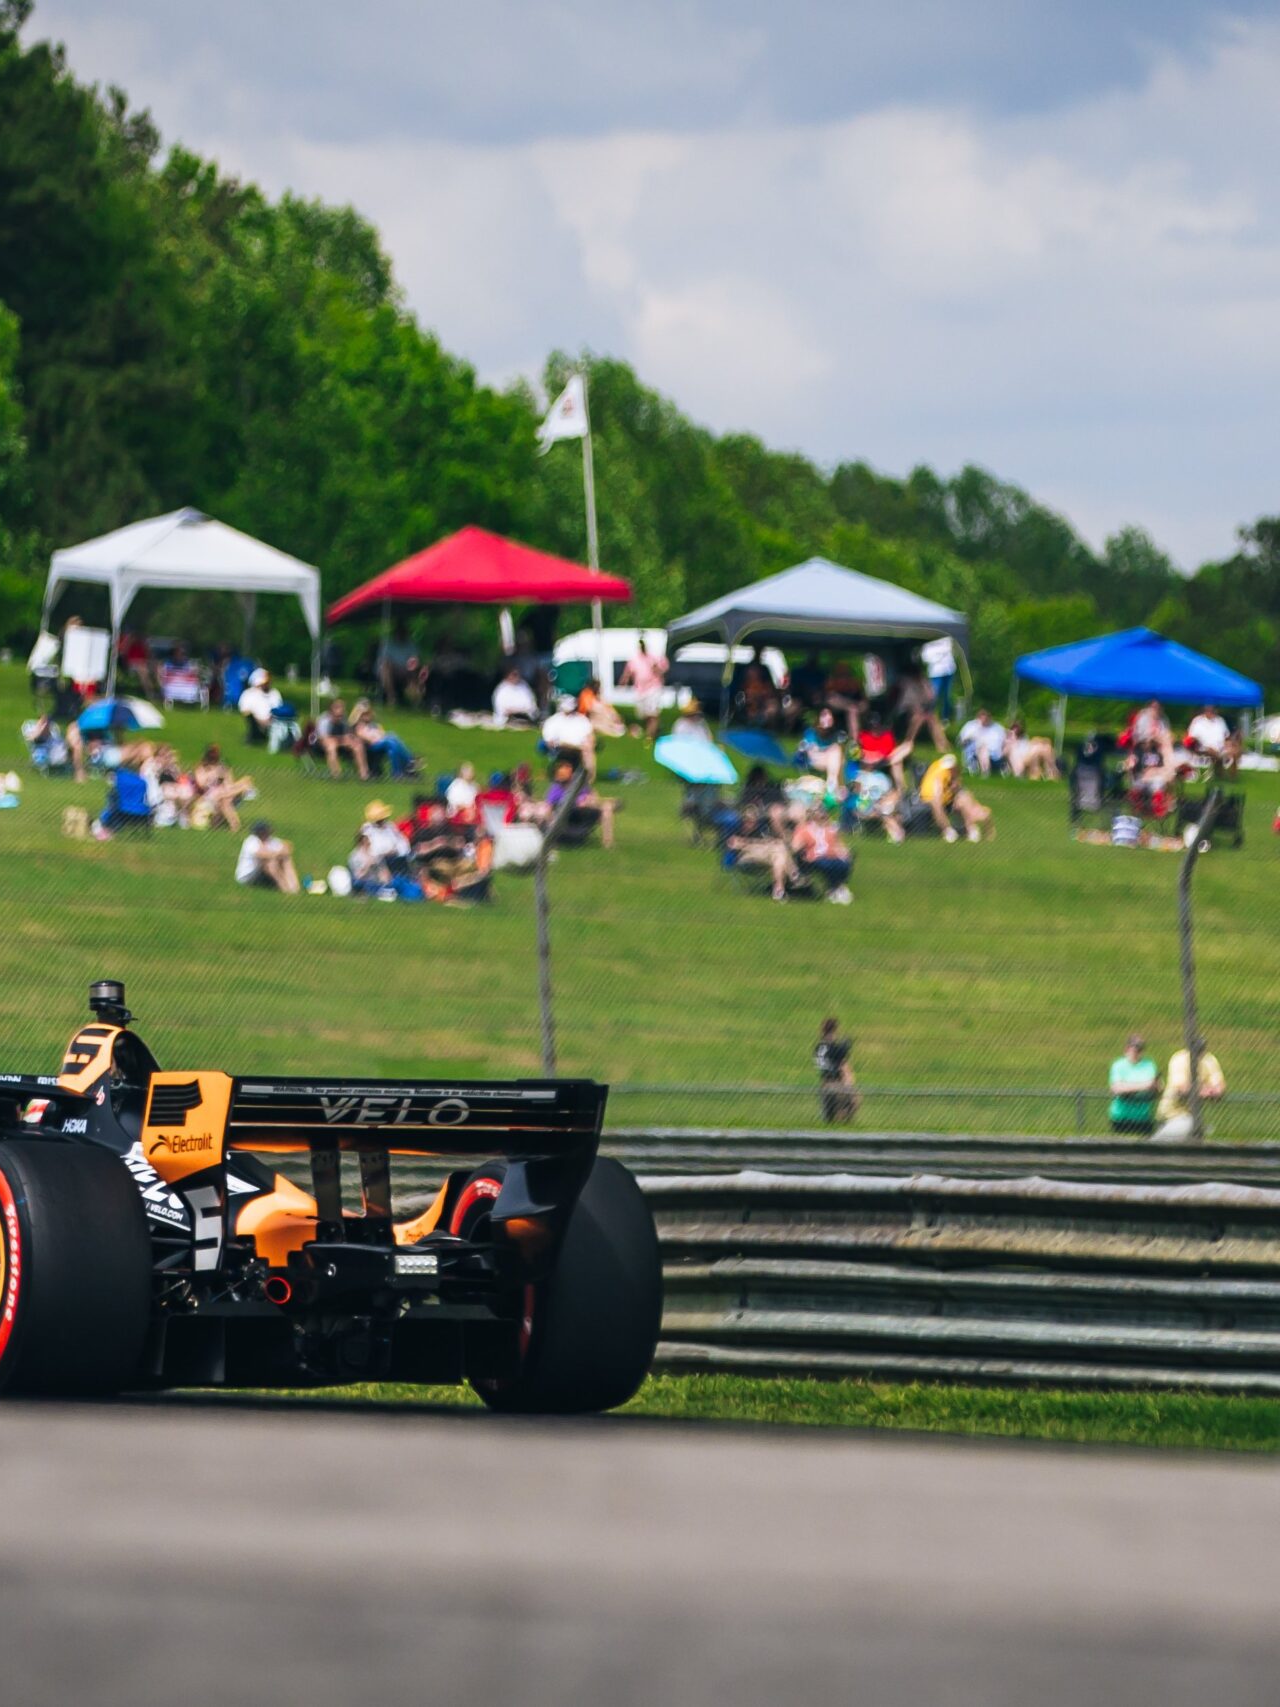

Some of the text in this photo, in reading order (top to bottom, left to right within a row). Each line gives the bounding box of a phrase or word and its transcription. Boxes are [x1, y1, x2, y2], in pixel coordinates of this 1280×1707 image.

[319, 1096, 470, 1125] VELO
[61, 1118, 88, 1133] HOKA
[172, 1132, 213, 1154] Electrolit
[5, 1203, 20, 1322] Firestone
